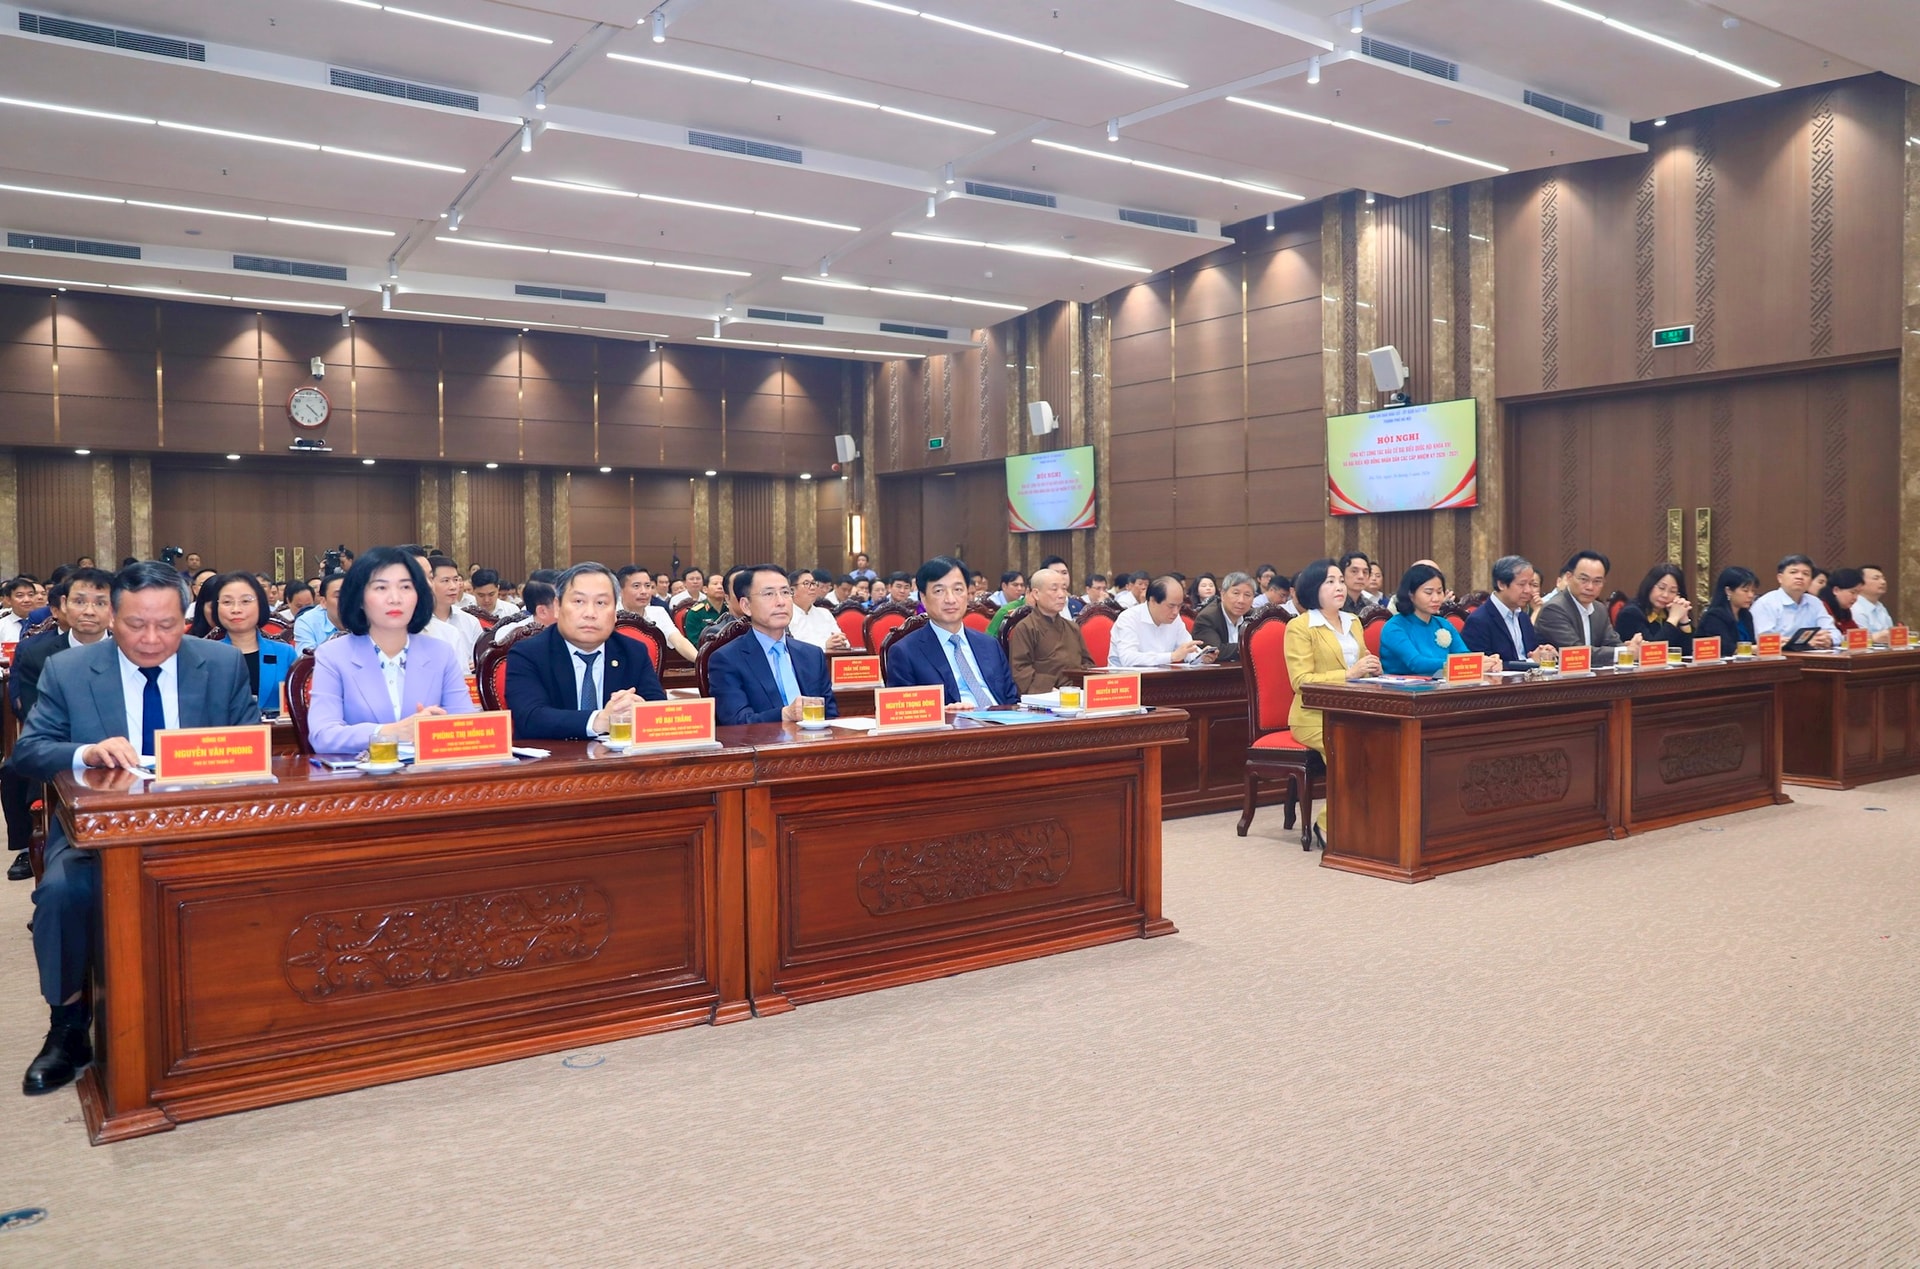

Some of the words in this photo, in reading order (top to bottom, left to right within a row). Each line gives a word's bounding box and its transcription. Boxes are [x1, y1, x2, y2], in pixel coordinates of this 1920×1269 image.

[432, 730, 455, 740] PHÙNG
[456, 730, 466, 739] THỊ
[174, 745, 206, 758] NGUYỄN
[207, 746, 224, 756] VĂN
[226, 745, 253, 756] PHONG
